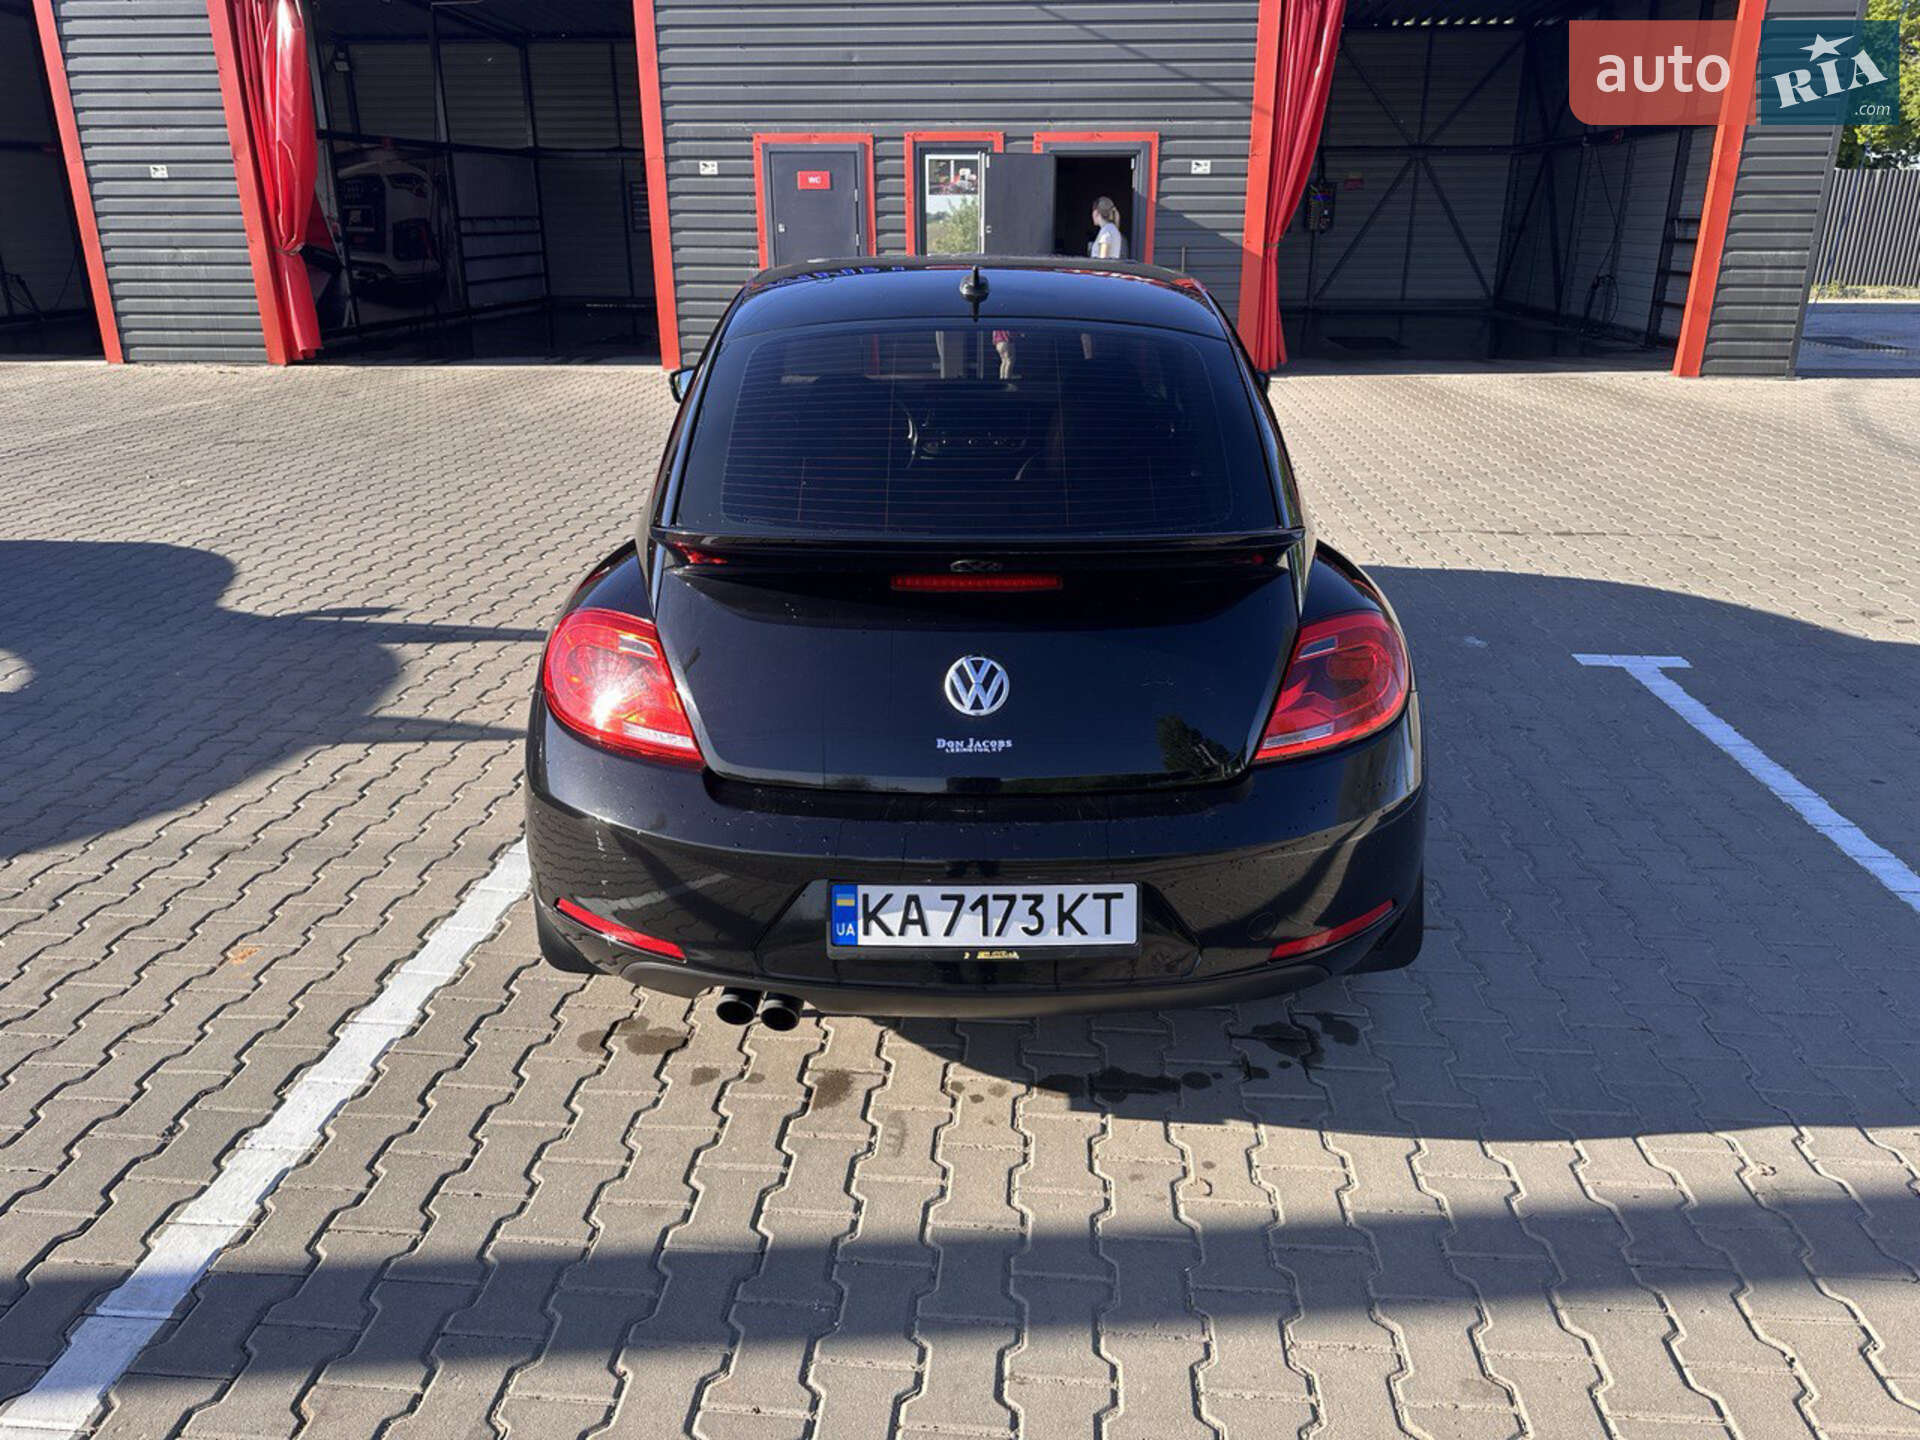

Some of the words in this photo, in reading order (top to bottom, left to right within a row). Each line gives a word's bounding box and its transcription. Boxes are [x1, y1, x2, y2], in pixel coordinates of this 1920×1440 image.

[808, 176, 822, 184] WC
[862, 893, 929, 937] KA
[940, 893, 1046, 937] 7173
[1057, 892, 1124, 937] KT
[836, 923, 855, 937] UA
